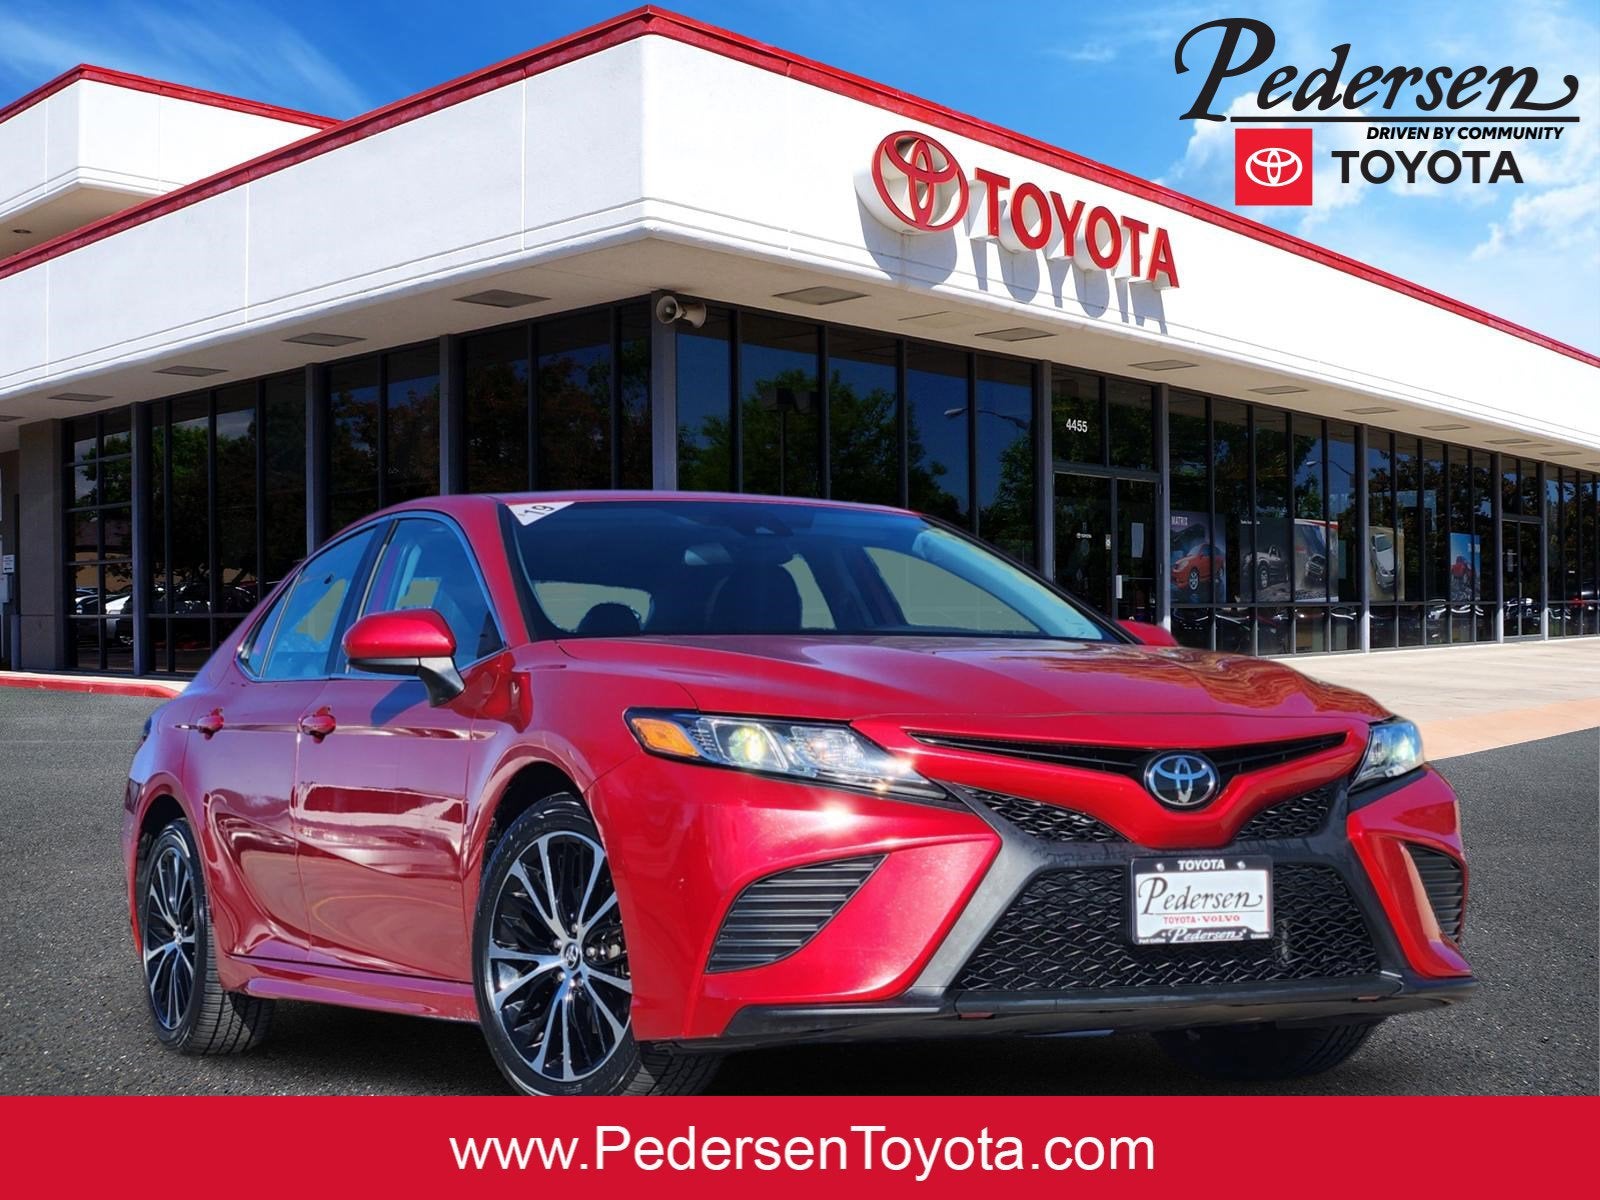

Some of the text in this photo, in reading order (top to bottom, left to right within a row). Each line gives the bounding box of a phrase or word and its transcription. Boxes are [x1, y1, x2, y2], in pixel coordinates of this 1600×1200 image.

[974, 167, 1180, 289] TOYOTA
[1065, 418, 1088, 433] 4455
[1177, 859, 1226, 871] TOYOTA
[1138, 876, 1264, 915] Pedersen
[1163, 914, 1240, 925] TOYOTA VOLVO
[1168, 926, 1244, 941] Pedersen
